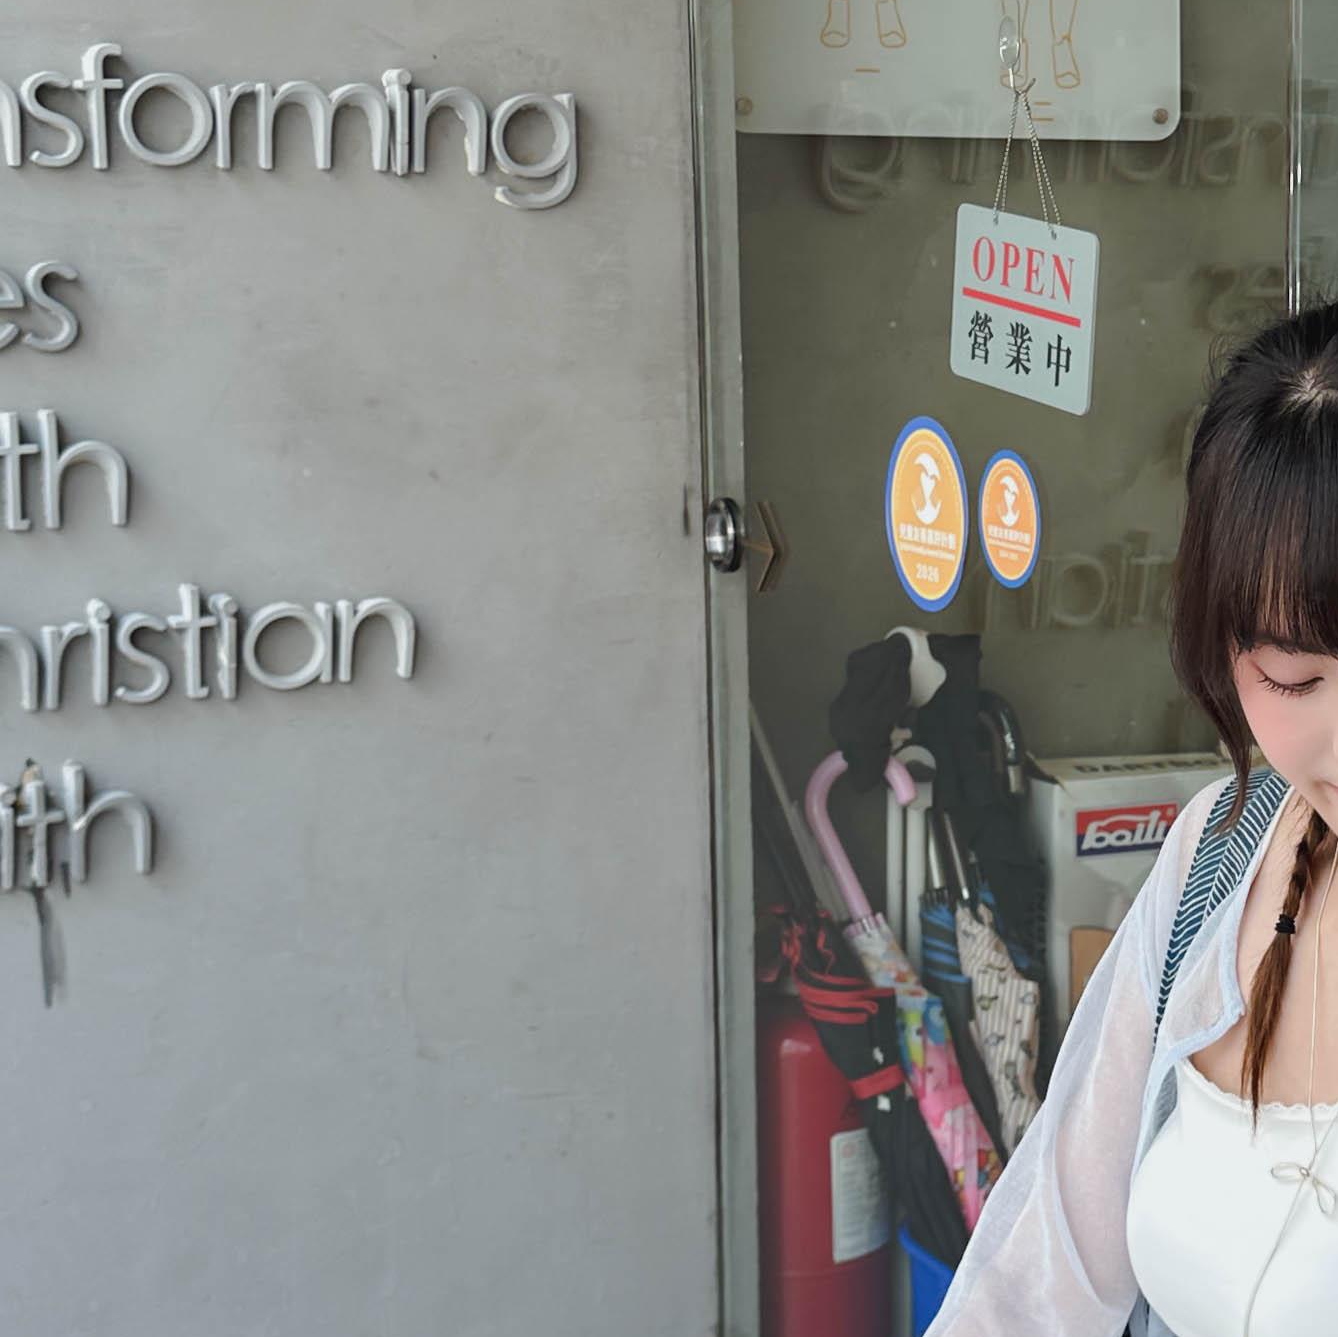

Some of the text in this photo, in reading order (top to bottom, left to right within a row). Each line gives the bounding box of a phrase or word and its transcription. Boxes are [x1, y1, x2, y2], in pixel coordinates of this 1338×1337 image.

[972, 235, 1075, 304] OPEN
[967, 310, 1072, 387] 營業中
